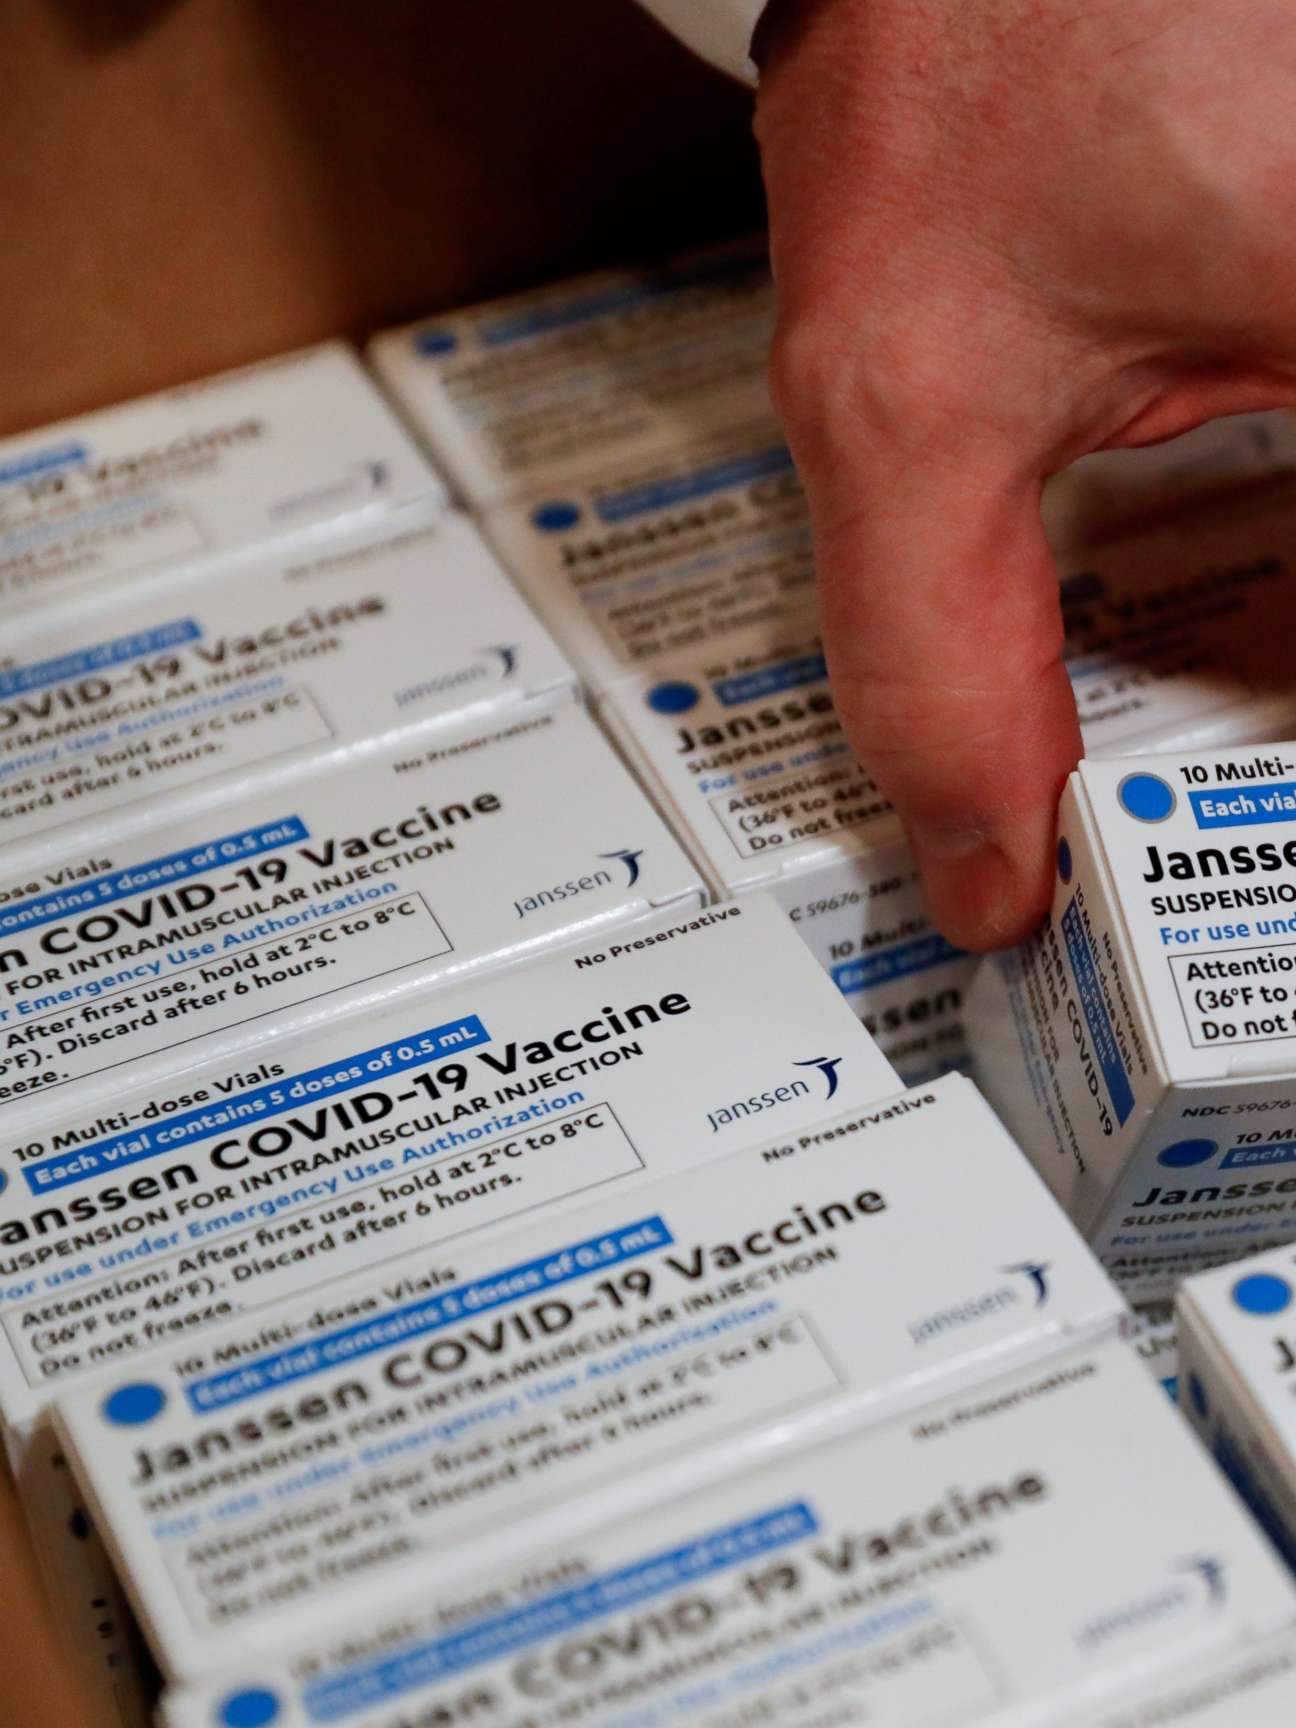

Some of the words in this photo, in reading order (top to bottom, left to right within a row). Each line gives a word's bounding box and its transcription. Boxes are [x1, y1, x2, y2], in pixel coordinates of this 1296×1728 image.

[677, 693, 835, 753] Jansse
[1178, 764, 1209, 785] 10
[1198, 794, 1257, 818] Each
[4, 967, 65, 997] FOR
[67, 887, 309, 976] INTRAMUSCULAR
[311, 836, 456, 895] INJECTION
[39, 858, 287, 956] COVID-19
[294, 793, 503, 869] Vaccine
[513, 870, 612, 919] janssen
[5, 1016, 75, 1050] After
[79, 995, 139, 1023] first
[141, 980, 196, 1003] use,
[198, 951, 260, 984] hold
[265, 944, 293, 962] at
[294, 927, 338, 952] 2°C
[339, 919, 370, 936] to
[372, 900, 416, 924] 8°C
[14, 959, 161, 1017] Emergency
[165, 942, 216, 965] Use
[222, 881, 398, 949] Authorization
[573, 952, 606, 969] No
[608, 906, 741, 958] Preservative
[1158, 926, 1200, 945] For
[1206, 922, 1251, 941] use
[55, 1007, 158, 1055] Discard
[163, 988, 227, 1019] after
[233, 979, 250, 995] 6
[250, 955, 337, 989] hours.
[1193, 985, 1254, 1014] (36°F
[1258, 985, 1288, 1004] to
[1200, 1020, 1237, 1040] Do
[1242, 1013, 1288, 1036] not
[0, 1162, 200, 1258] anssen
[209, 1063, 467, 1171] COVID-19
[474, 992, 692, 1076] Vaccine
[11, 1141, 45, 1161] 10
[50, 1089, 209, 1150] Multi-dose
[210, 1064, 284, 1093] Vials
[33, 1153, 99, 1185] Each
[100, 1132, 152, 1161] vial
[154, 1098, 267, 1144] contains
[267, 1089, 285, 1106] 5
[287, 1066, 362, 1099] doses
[364, 1051, 392, 1073] of
[395, 1040, 433, 1062] 0.5
[437, 1027, 475, 1048] mL
[173, 1184, 237, 1217] FOR
[239, 1097, 491, 1194] INTRAMUSCULAR
[493, 1040, 644, 1105] INJECTION
[706, 1080, 810, 1133] janssen
[1181, 1105, 1230, 1118] NDC
[1236, 1132, 1262, 1144] 10
[43, 1262, 93, 1288] use
[97, 1230, 180, 1269] under
[185, 1175, 337, 1239] Emergency
[342, 1158, 395, 1183] Use
[401, 1090, 585, 1164] Authorization
[176, 1239, 249, 1277] After
[253, 1216, 315, 1247] first
[318, 1200, 376, 1225] use,
[377, 1168, 442, 1204] hold
[446, 1160, 476, 1180] at
[477, 1141, 523, 1169] 2°C
[524, 1133, 556, 1151] to
[559, 1112, 604, 1138] 8°C
[1231, 1148, 1287, 1162] Each
[229, 1230, 337, 1283] Discard
[341, 1209, 408, 1243] after
[414, 1199, 432, 1216] 6
[432, 1173, 522, 1209] hours.
[380, 1269, 652, 1389] COVID-19
[659, 1189, 888, 1283] Vaccine
